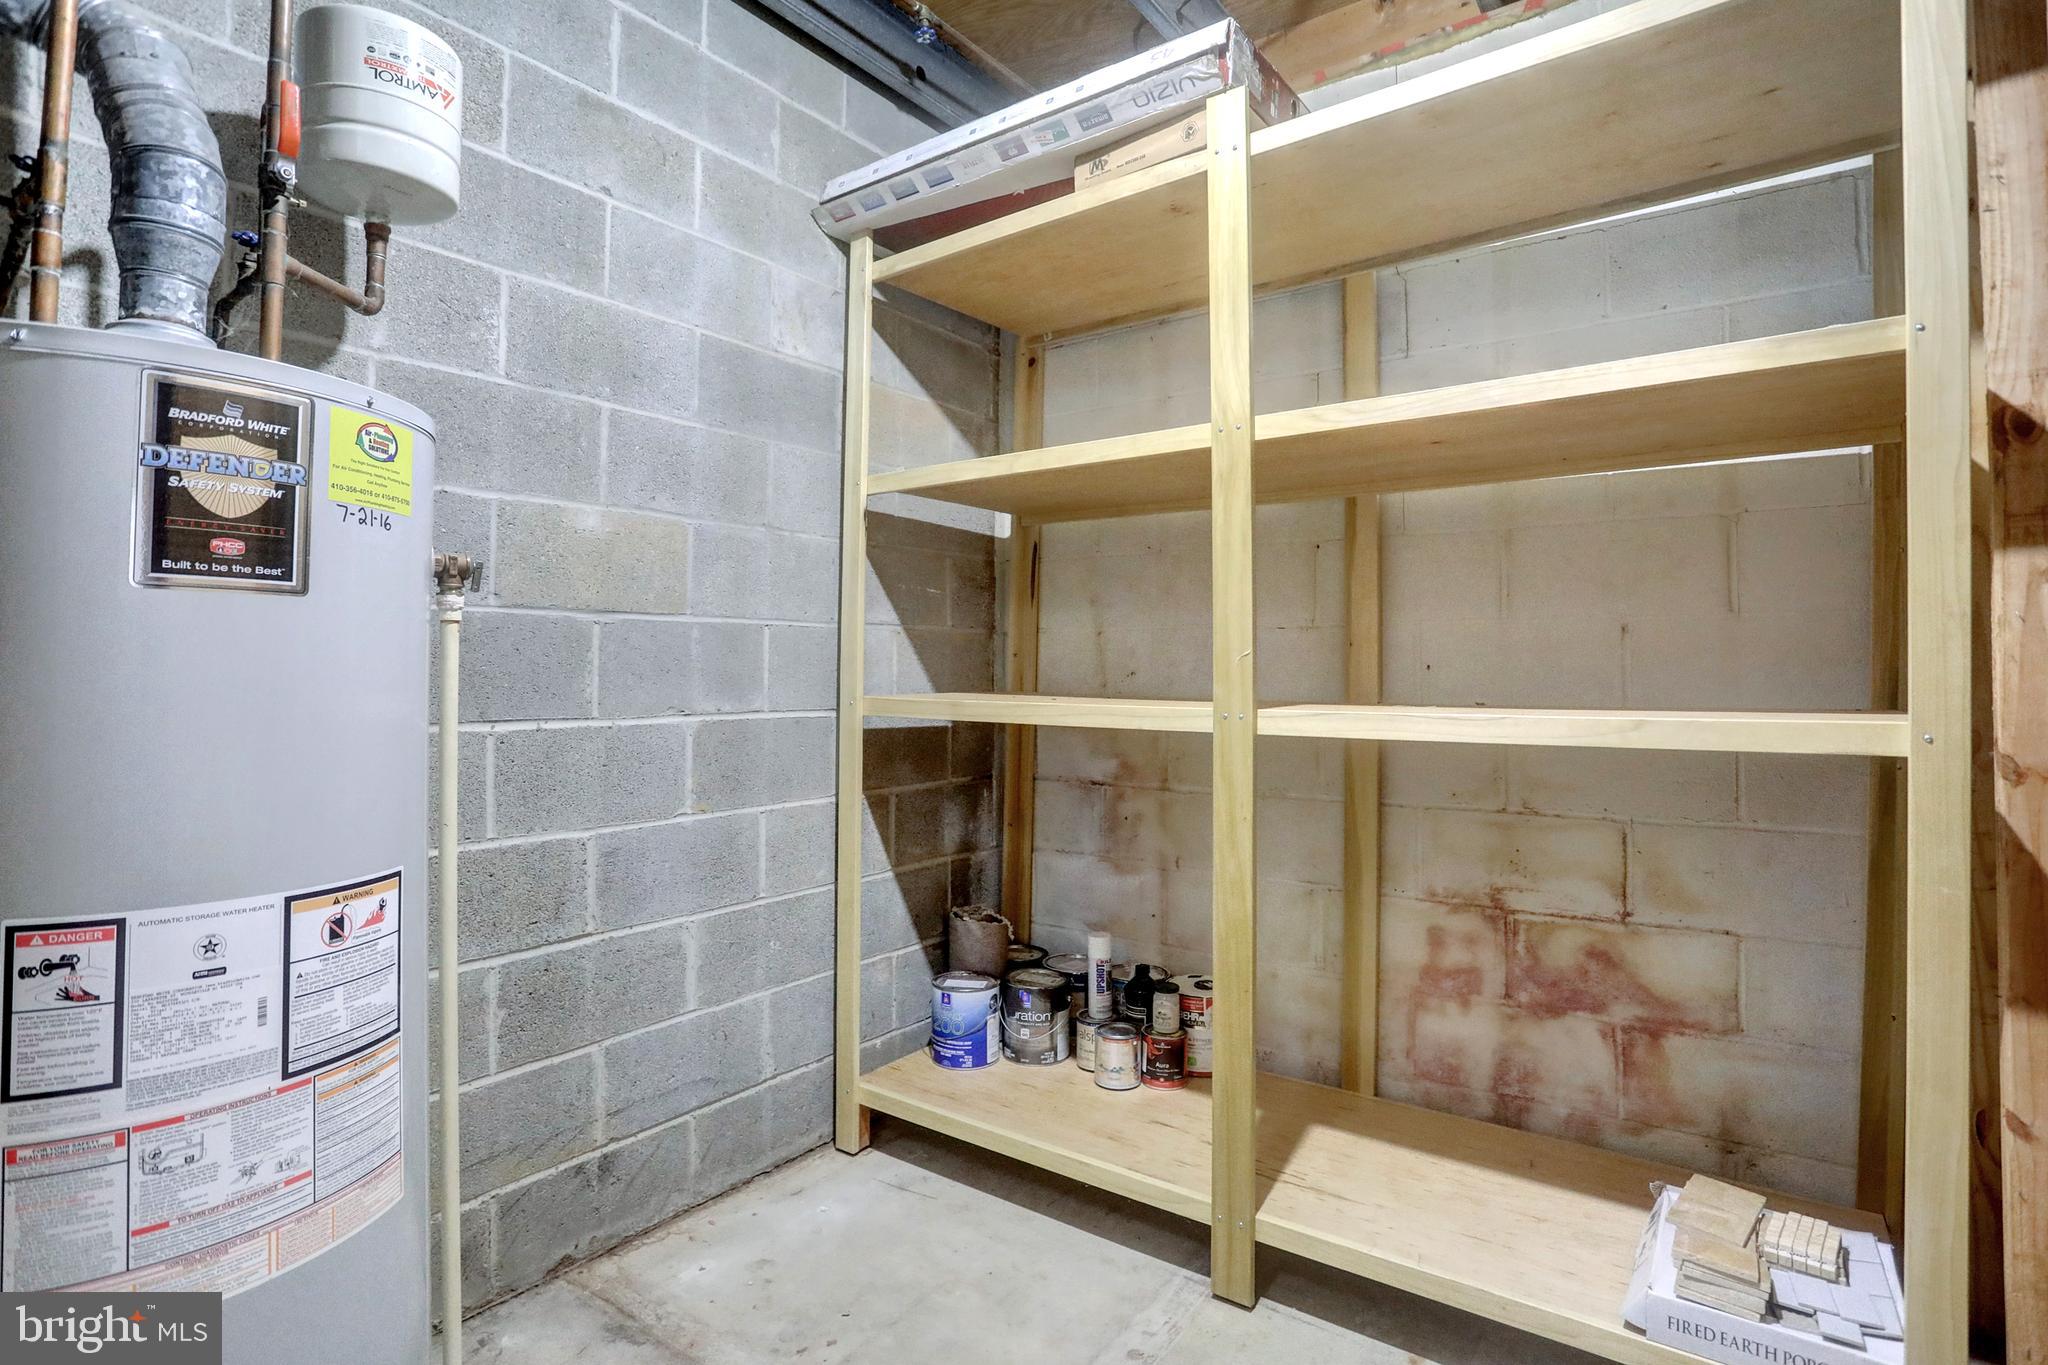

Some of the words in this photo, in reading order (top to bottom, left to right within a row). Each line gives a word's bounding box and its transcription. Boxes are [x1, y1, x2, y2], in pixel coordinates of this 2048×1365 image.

[368, 66, 438, 99] AMTROL
[1132, 76, 1196, 108] VIZIO
[168, 407, 244, 428] BRADFORD
[247, 419, 288, 436] WHITE
[178, 420, 281, 440] CORPORATION
[140, 442, 308, 487] DEFENDER
[168, 475, 224, 492] SAFETY
[228, 482, 284, 499] SYSTEM
[166, 518, 230, 531] ENERGY
[240, 525, 286, 536] SAVER
[162, 559, 192, 570] Built
[194, 560, 208, 570] to
[212, 562, 228, 572] be
[232, 564, 251, 574] the
[255, 566, 282, 576] Best
[342, 888, 374, 902] WARNING
[138, 916, 183, 927] AUTOMATIC
[185, 912, 221, 922] STORAGE
[222, 908, 248, 916] WATER
[249, 904, 275, 913] HEATER
[48, 931, 103, 944] DANGER
[1096, 964, 1105, 994] UPSHOT
[189, 1104, 227, 1120] OPERATING
[229, 1092, 272, 1109] INSTRUCTIONS
[1668, 1315, 1716, 1342] FIRED
[1721, 1332, 1778, 1363] EARTH
